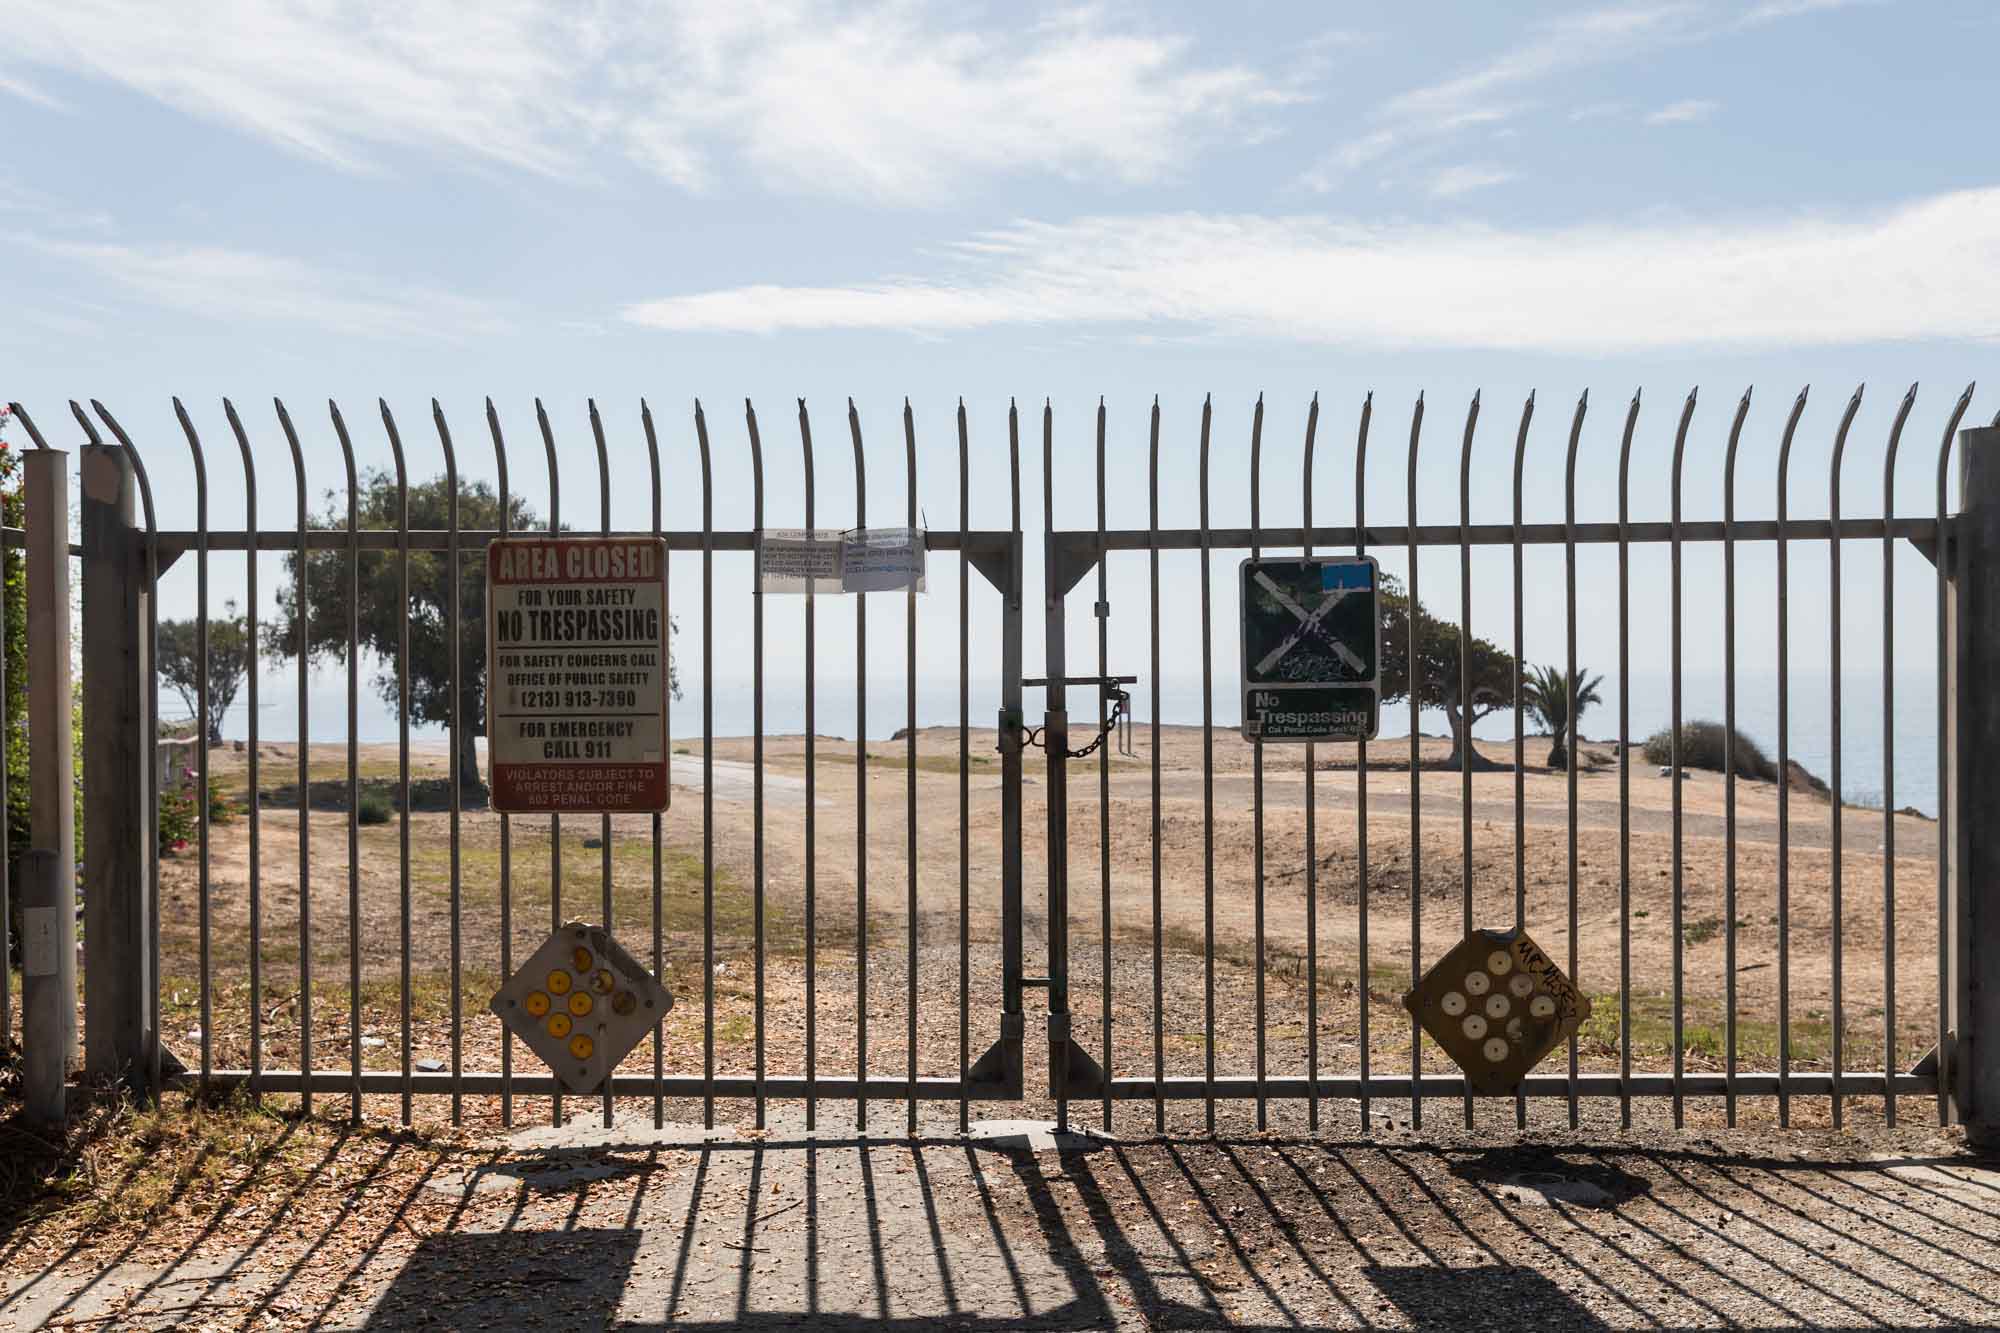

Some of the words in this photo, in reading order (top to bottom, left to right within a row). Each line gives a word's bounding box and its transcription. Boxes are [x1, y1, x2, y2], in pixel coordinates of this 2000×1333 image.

[500, 546, 560, 579] AREA
[566, 545, 656, 579] CLOSED
[518, 590, 542, 606] FOR
[547, 589, 582, 606] YOUR
[586, 588, 636, 605] SAFETY
[498, 609, 523, 642] NO
[528, 608, 658, 641] TRESPASSING
[500, 655, 521, 668] FOR
[524, 655, 563, 668] SAFETY
[567, 654, 628, 667] CONCERNS
[630, 653, 656, 666] CALL
[508, 673, 545, 686] OFFICE
[549, 673, 563, 686] OF
[565, 673, 606, 686] PUBLIC
[608, 672, 649, 685] SAFETY
[521, 691, 560, 708] (213)
[1255, 692, 1281, 708] No
[1255, 709, 1368, 727] Trespassing
[520, 722, 546, 738] FOR
[551, 721, 634, 738] EMERGENCY
[543, 741, 580, 759] CALL
[585, 741, 612, 758] 911
[506, 768, 574, 781] VIOLATORS
[575, 768, 637, 781] SUBJECT
[639, 768, 655, 780] TO
[514, 781, 564, 793] ARREST
[617, 781, 646, 792] FINE
